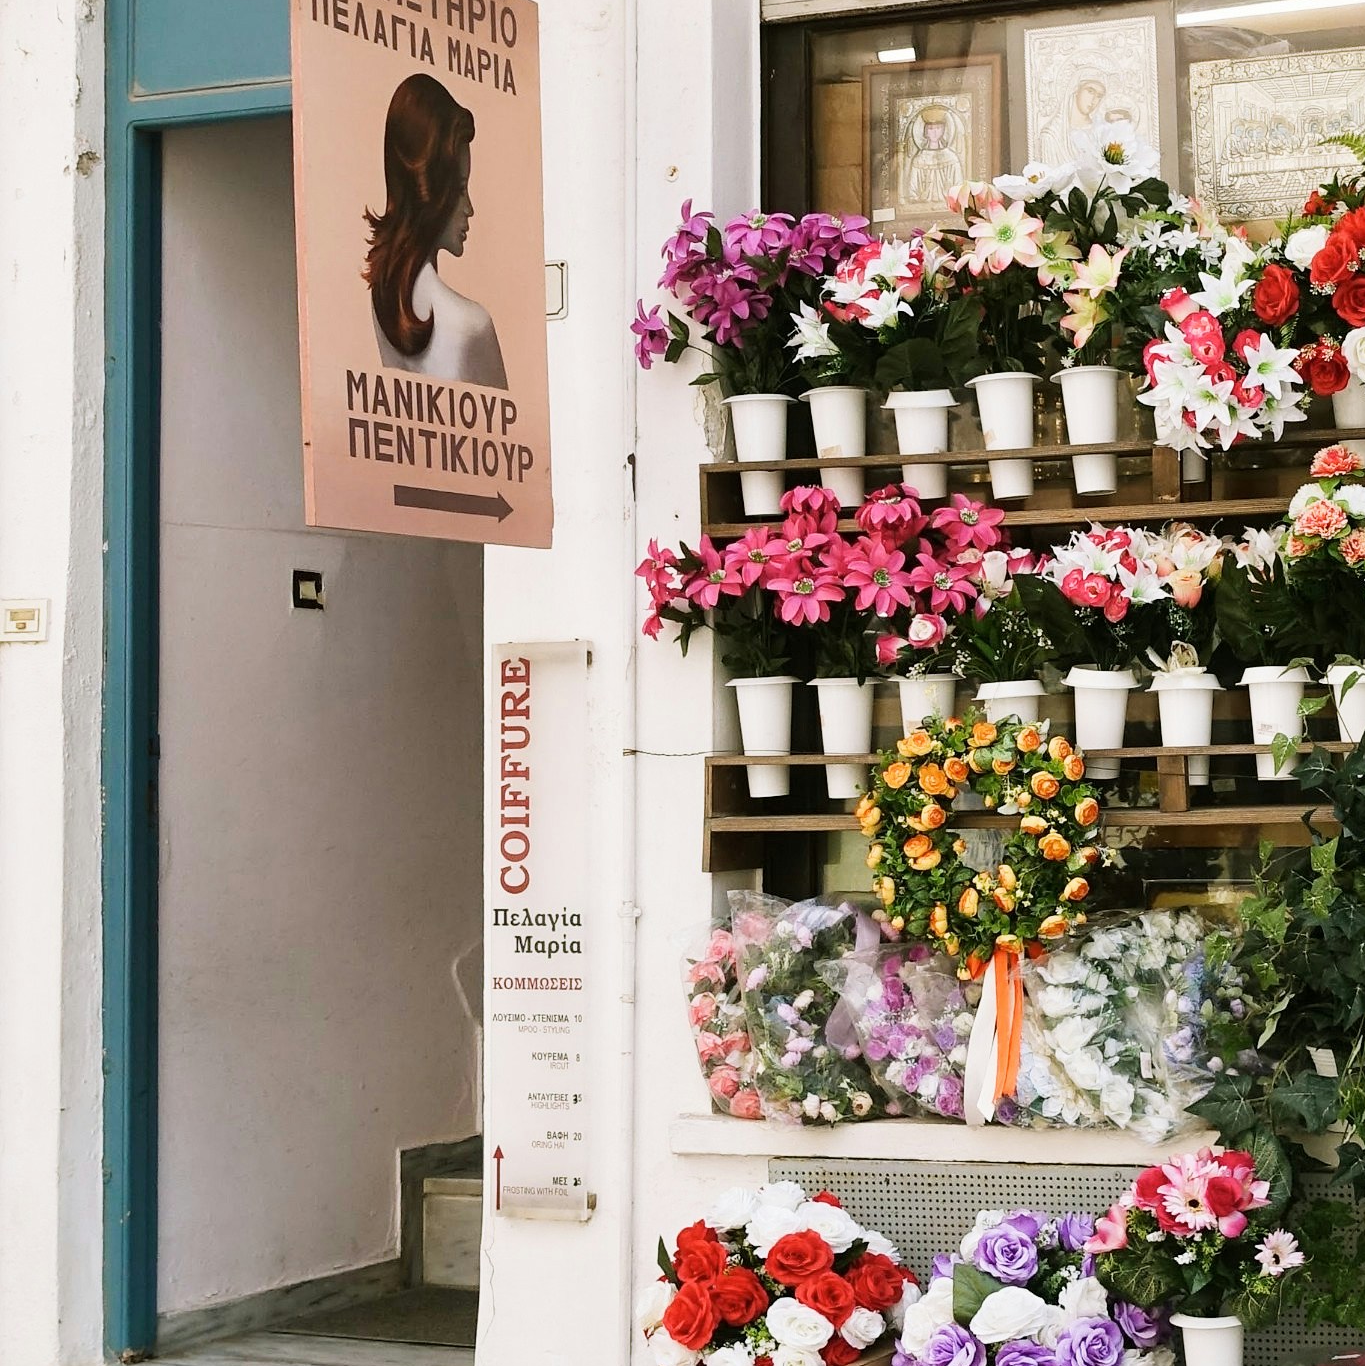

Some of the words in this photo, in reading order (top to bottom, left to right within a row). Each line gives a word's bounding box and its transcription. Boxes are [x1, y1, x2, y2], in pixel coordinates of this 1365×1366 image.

[448, 36, 518, 96] ΜΑΡΙΑ
[346, 369, 518, 428] ΜΑΝΙΚΙΟΥΡ
[348, 418, 534, 483] ΠΕΝΤΙΚΙΟΥΡ
[500, 656, 531, 895] COIFFURE
[493, 907, 582, 932] Πελαγία
[514, 934, 582, 959] Μαρία
[493, 977, 582, 990] ΚΟΜΜΩΣΕΙΣ
[532, 1014, 569, 1023] ΧΤΕΝΙΣΜΑ
[574, 1014, 582, 1023] 10
[531, 1052, 568, 1061] ΚΟΥΡΕΜΑ
[546, 1131, 568, 1140] ΒΑΦΗ
[573, 1132, 582, 1141] 20
[503, 1185, 536, 1195] FROSTING
[537, 1187, 553, 1196] WITH
[552, 1176, 568, 1186] ΜΕΣ
